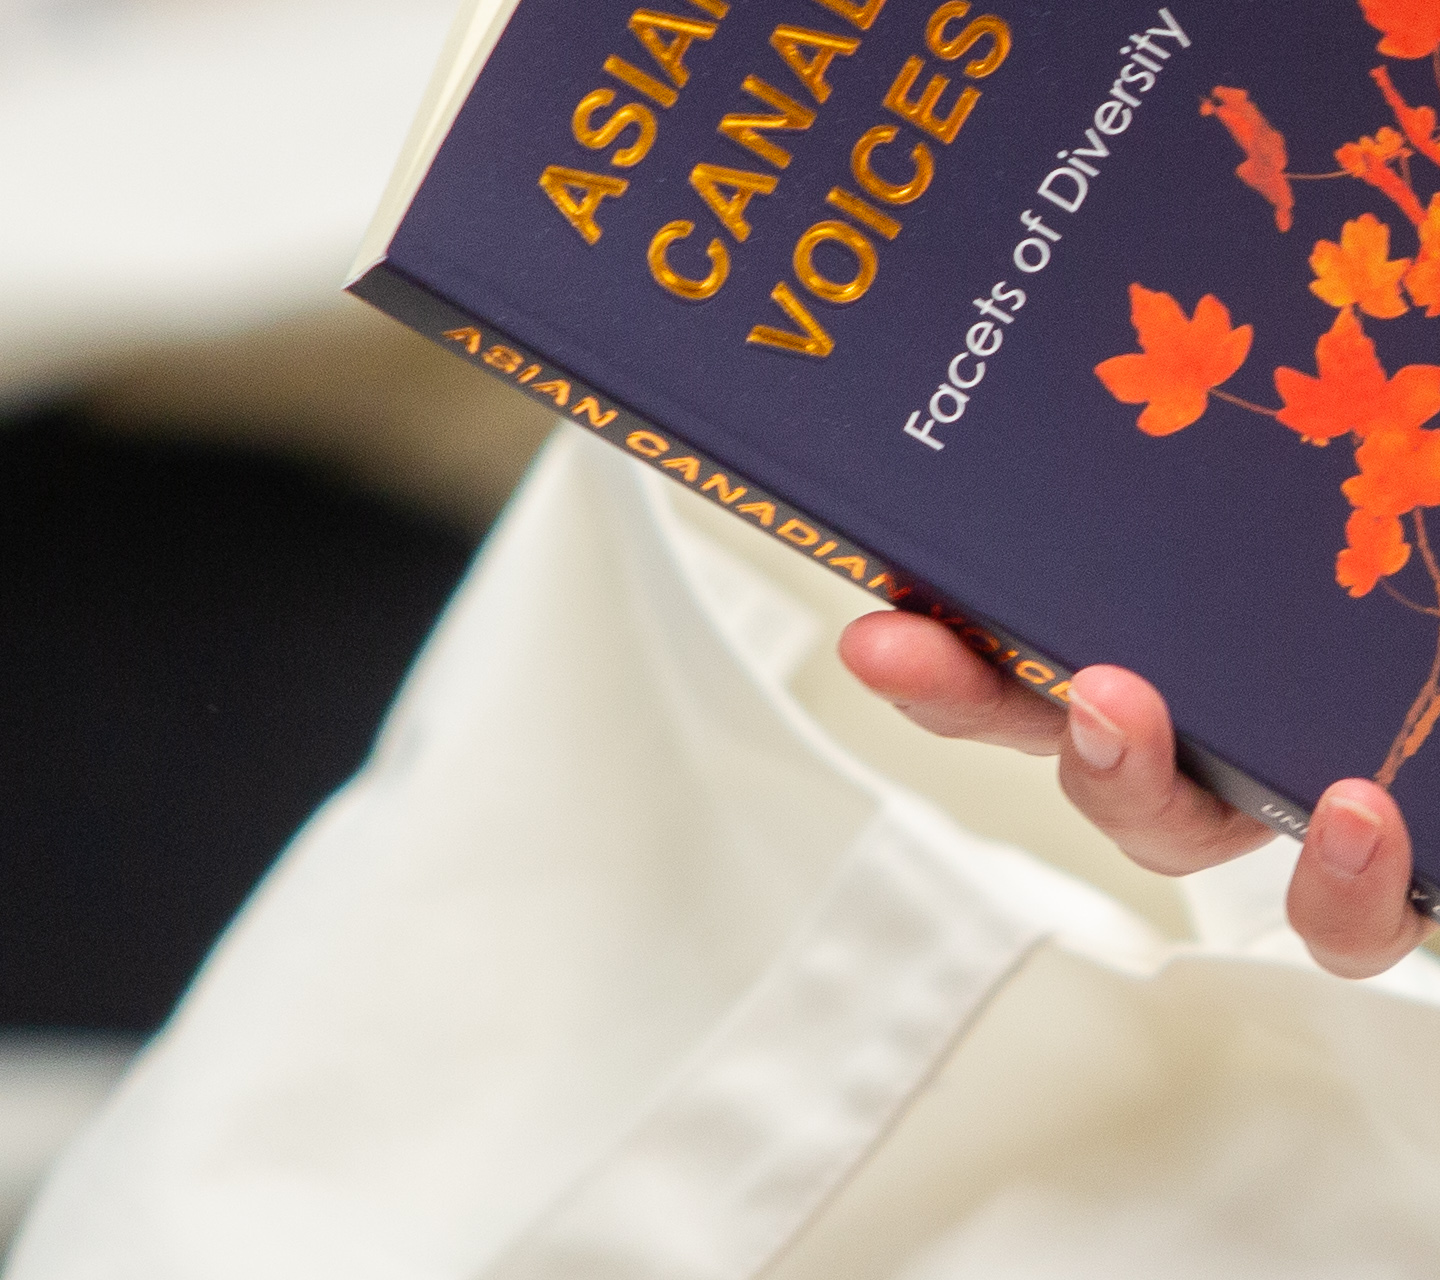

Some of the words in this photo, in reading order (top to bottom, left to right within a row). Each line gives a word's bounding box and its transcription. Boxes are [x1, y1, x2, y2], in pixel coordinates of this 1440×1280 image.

[1036, 6, 1193, 215] Diversity
[1012, 210, 1063, 273] of
[903, 276, 1028, 451] Facets
[442, 325, 619, 428] ASIAN
[625, 429, 911, 602] CANADIAN
